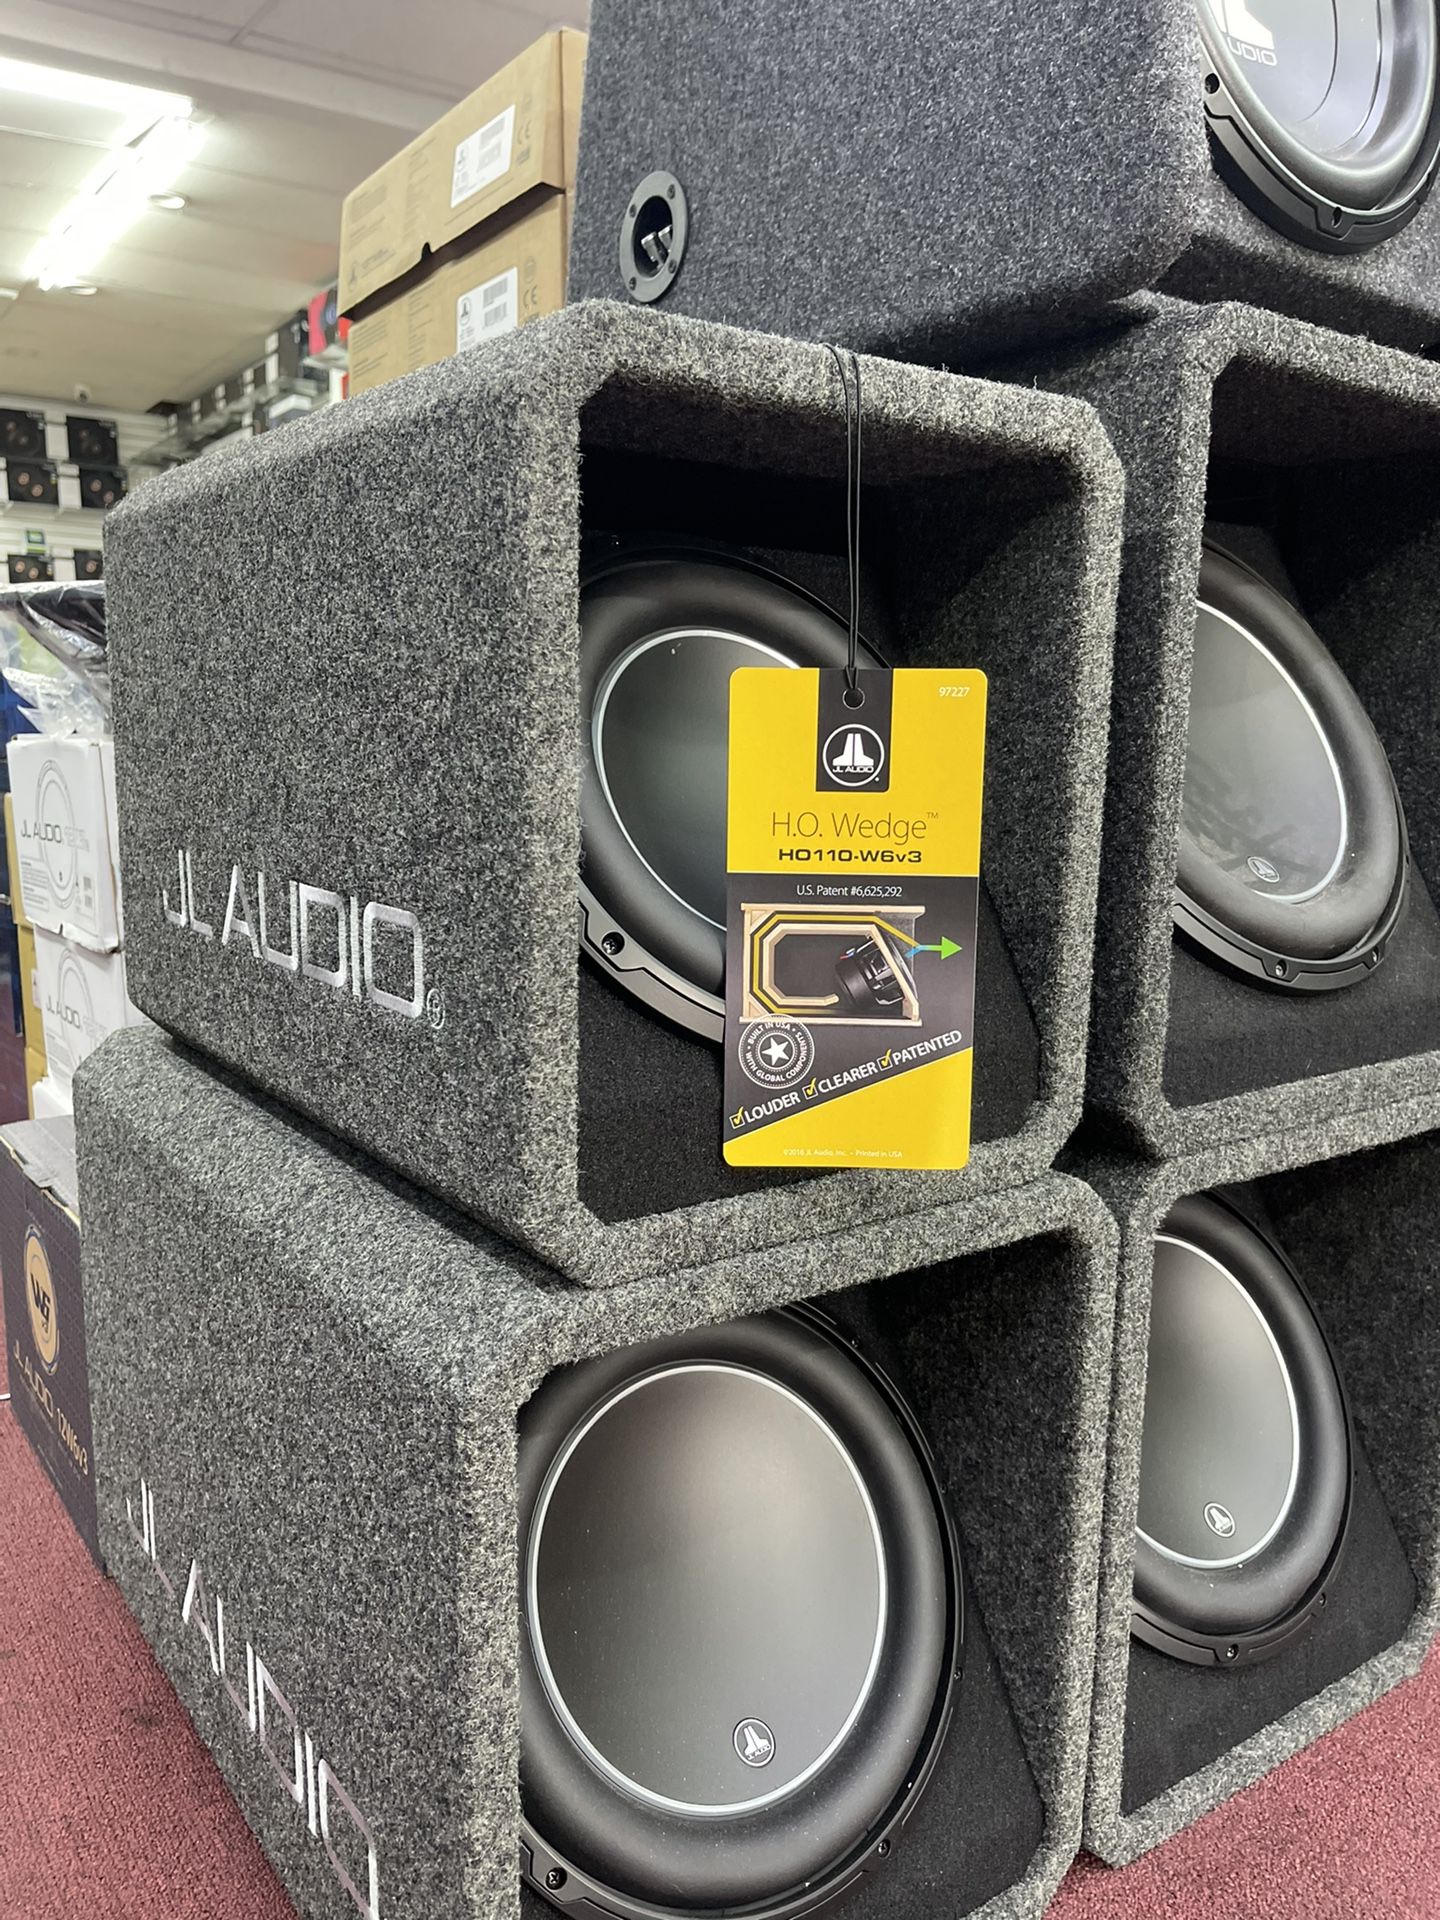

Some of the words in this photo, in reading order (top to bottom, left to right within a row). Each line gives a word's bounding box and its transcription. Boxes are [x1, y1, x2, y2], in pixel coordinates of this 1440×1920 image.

[1226, 36, 1278, 66] UDIO
[939, 686, 970, 697] 97227
[845, 765, 875, 773] AUDIO
[772, 811, 823, 838] H.O.
[778, 848, 923, 863] HO110-W6v3
[162, 850, 214, 939] JL
[796, 884, 815, 896] U.S.
[817, 885, 848, 896] Patent
[850, 885, 903, 897] #6,625,292
[747, 1025, 764, 1045] BUILT
[765, 1022, 774, 1030] IN
[775, 1022, 791, 1030] USA
[745, 1051, 759, 1072] WITH
[756, 1070, 786, 1082] GLOBAL
[785, 1032, 808, 1079] COMPONENTS
[744, 1091, 801, 1124] LOUDER
[817, 1061, 878, 1095] CLEARER
[892, 1029, 962, 1066] PATENTED
[855, 1149, 880, 1157] Printed
[182, 1558, 380, 1920] AUDIO
